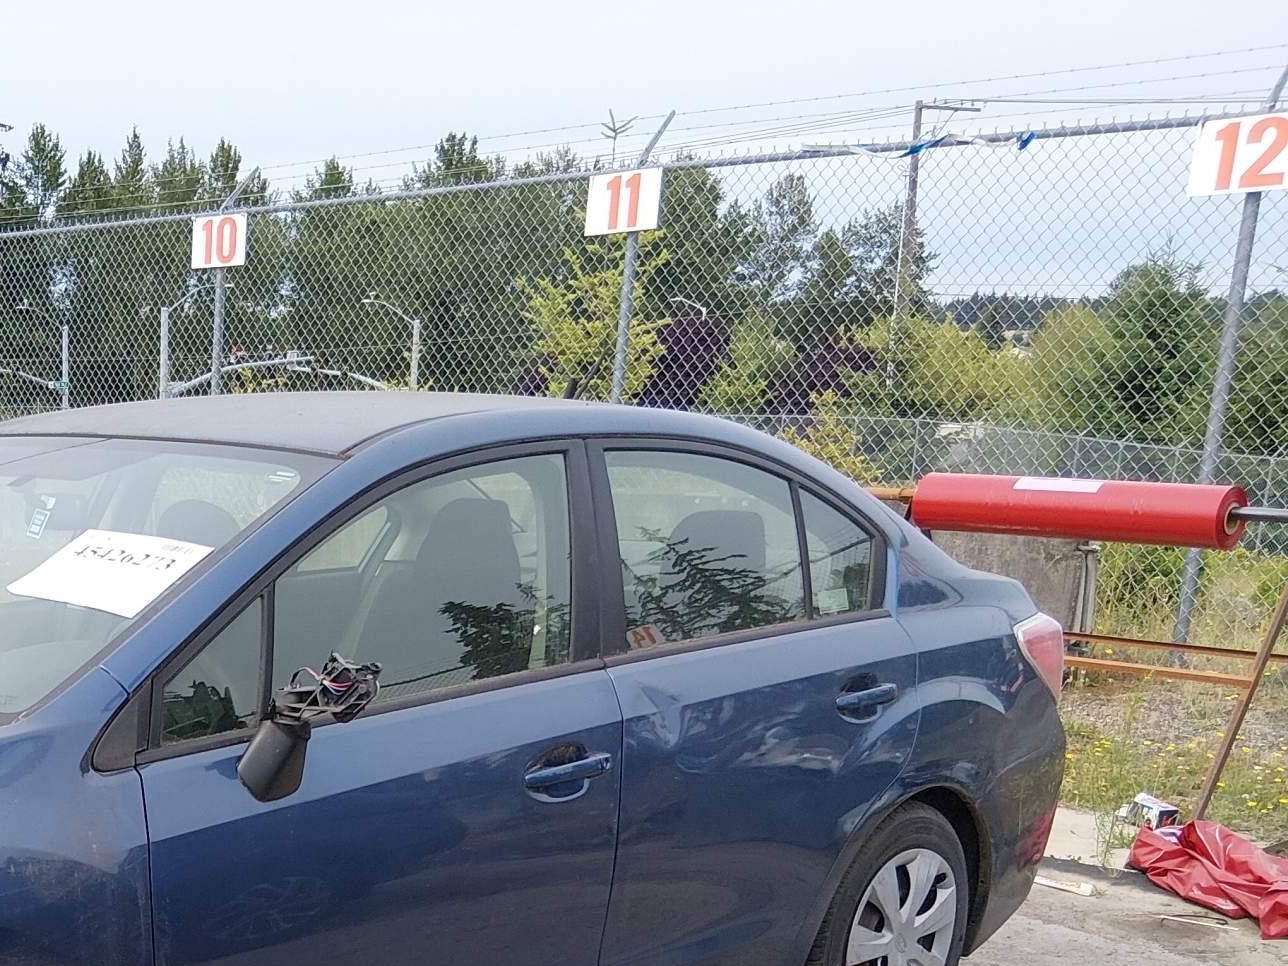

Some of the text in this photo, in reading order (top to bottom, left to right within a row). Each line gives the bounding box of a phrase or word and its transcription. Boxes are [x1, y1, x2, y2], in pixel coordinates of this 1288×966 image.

[1214, 116, 1288, 191] 12
[606, 172, 642, 231] 11
[202, 216, 238, 265] 10
